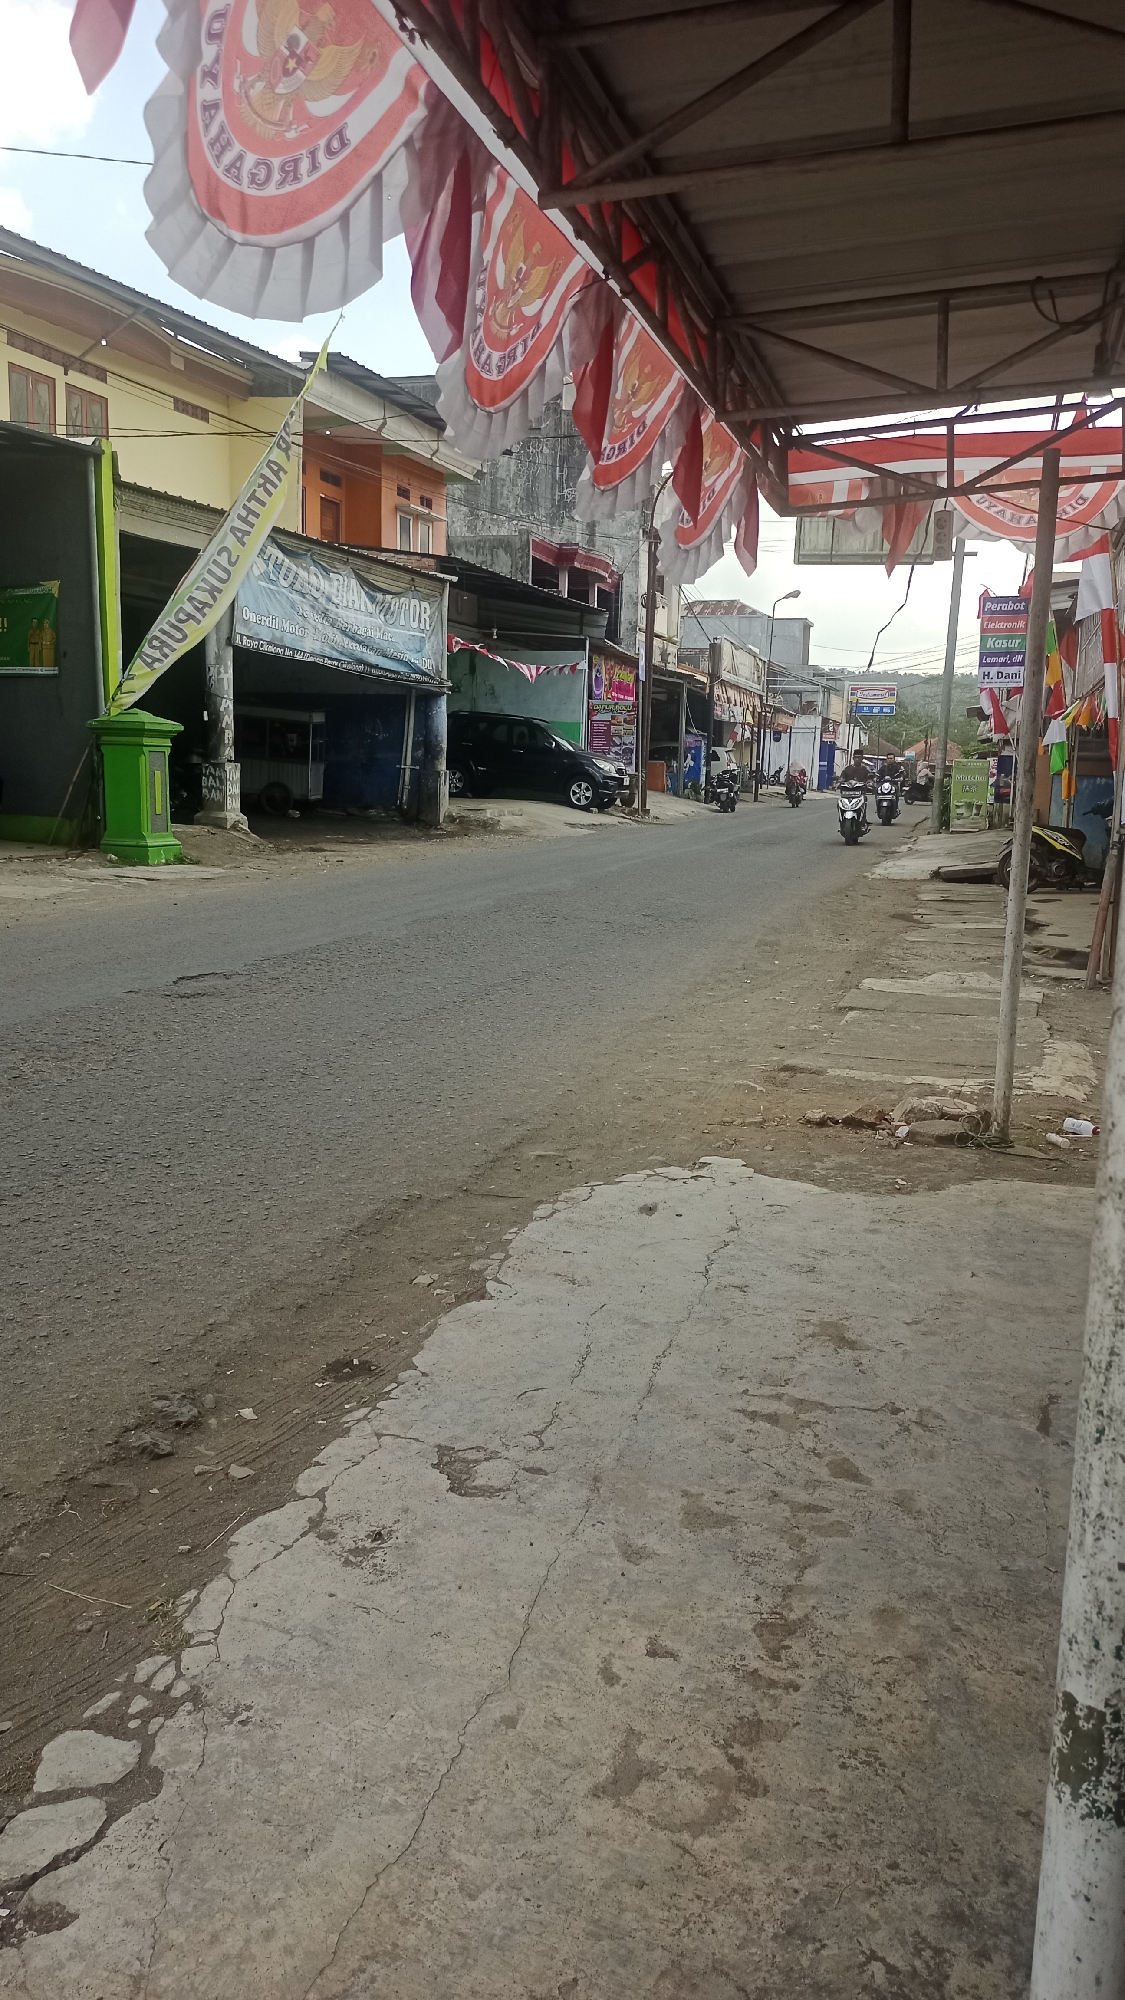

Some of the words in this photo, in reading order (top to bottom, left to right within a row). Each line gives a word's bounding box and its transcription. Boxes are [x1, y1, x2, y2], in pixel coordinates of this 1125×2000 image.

[984, 601, 1025, 611] Perabot
[242, 605, 279, 630] Onerdil
[280, 618, 309, 638] Motor
[983, 620, 1025, 629] Elektronik
[986, 637, 1021, 648] Kasur
[996, 670, 1021, 680] Dani
